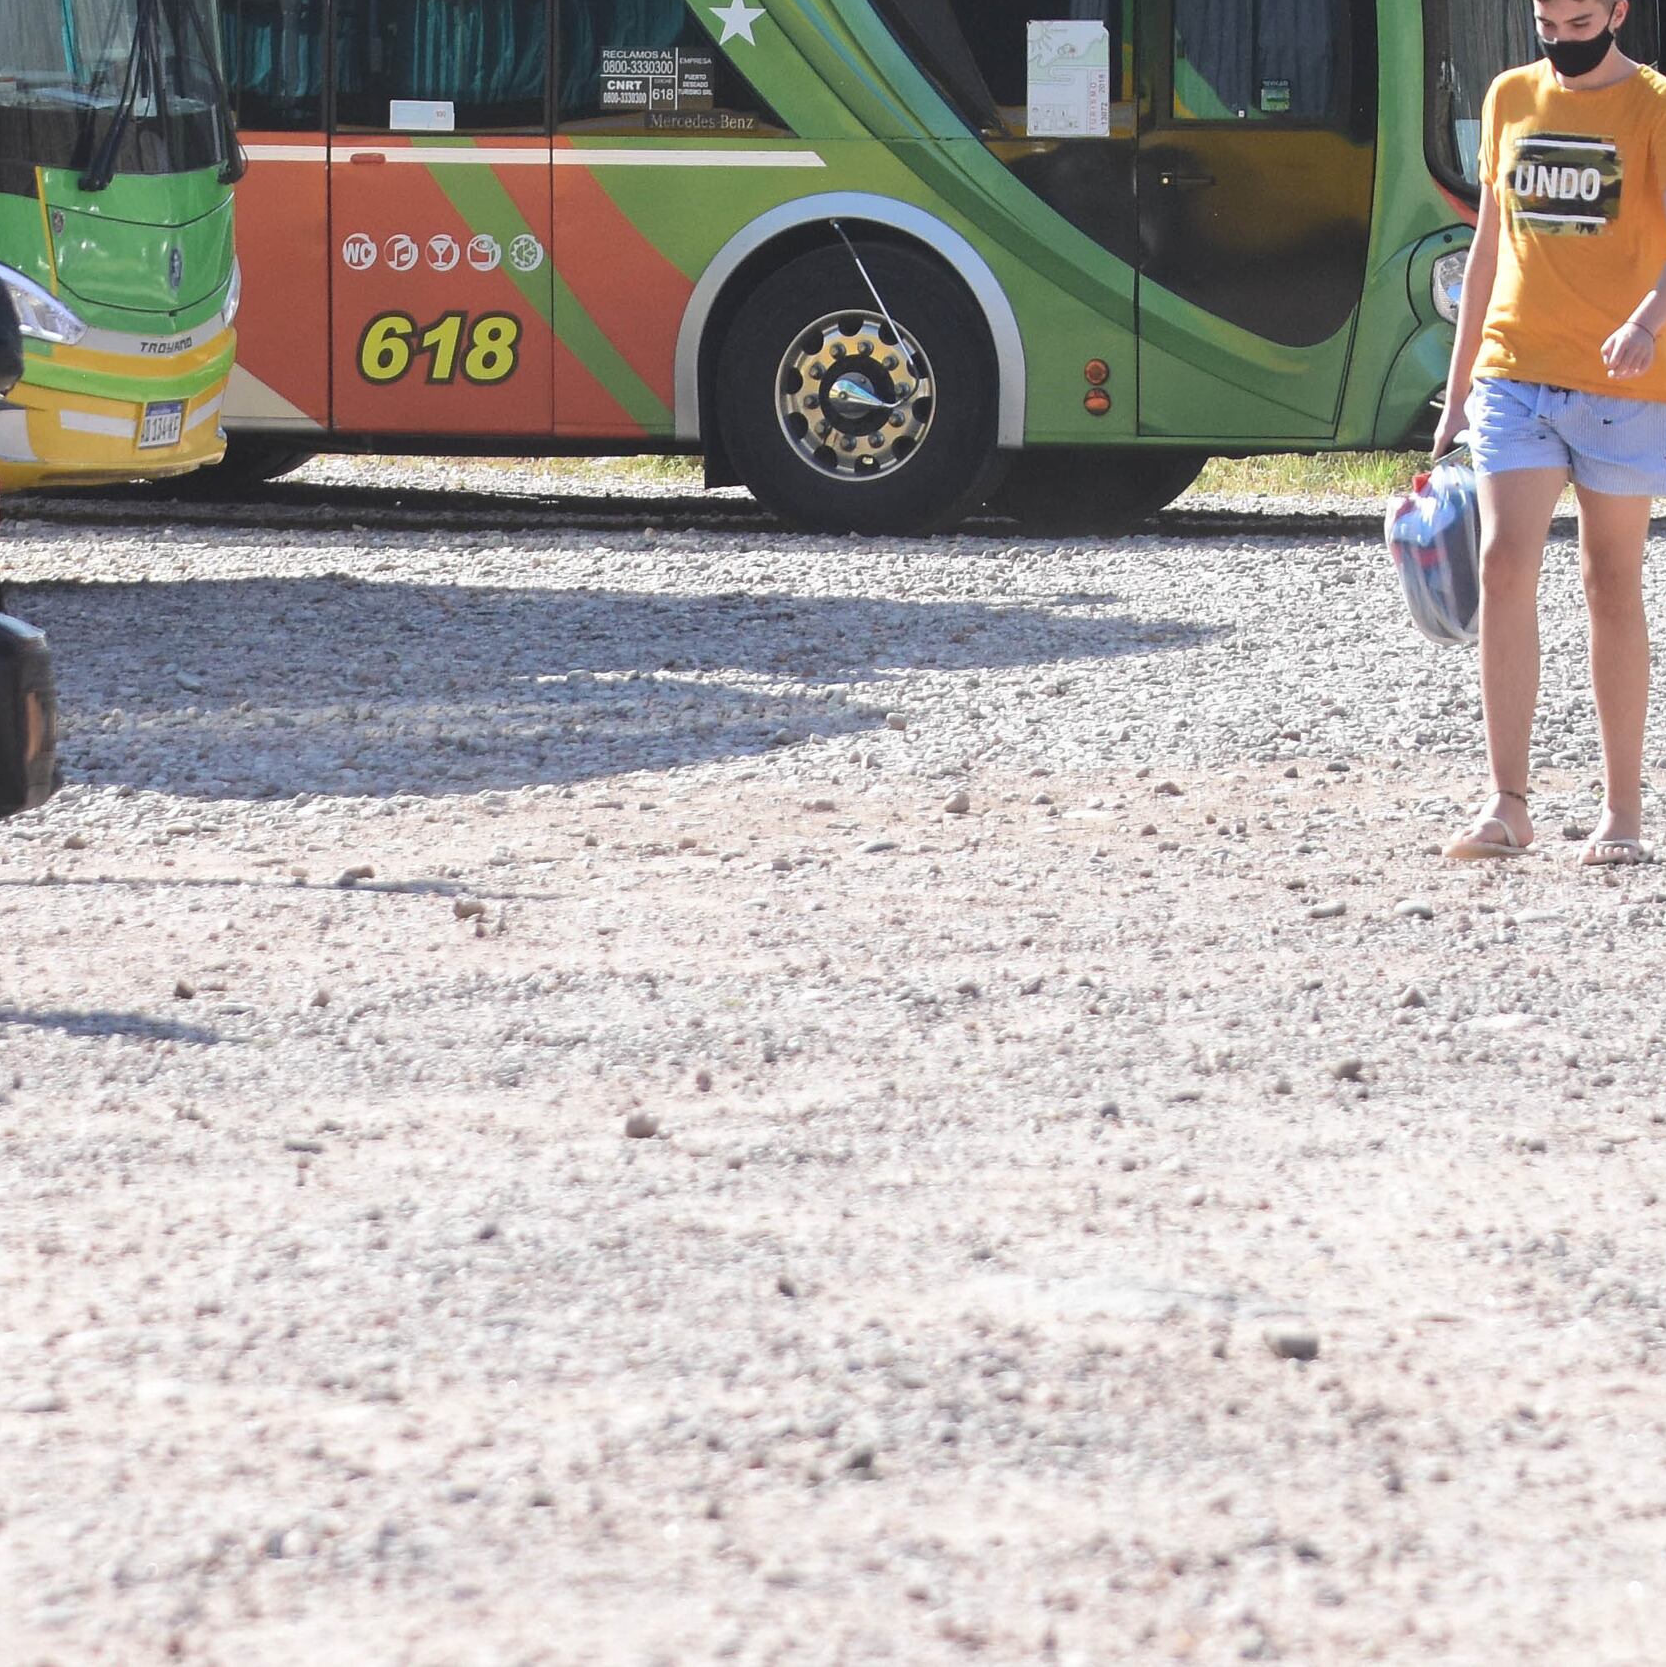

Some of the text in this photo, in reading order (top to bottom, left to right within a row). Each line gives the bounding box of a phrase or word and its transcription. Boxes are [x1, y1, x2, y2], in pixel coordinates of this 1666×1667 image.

[602, 50, 674, 60] RECLAMOS AL
[602, 60, 674, 74] 0800-3330300
[606, 80, 643, 91] CNRT
[652, 89, 674, 101] 618
[1514, 164, 1601, 201] UNDO
[356, 310, 522, 384] 618
